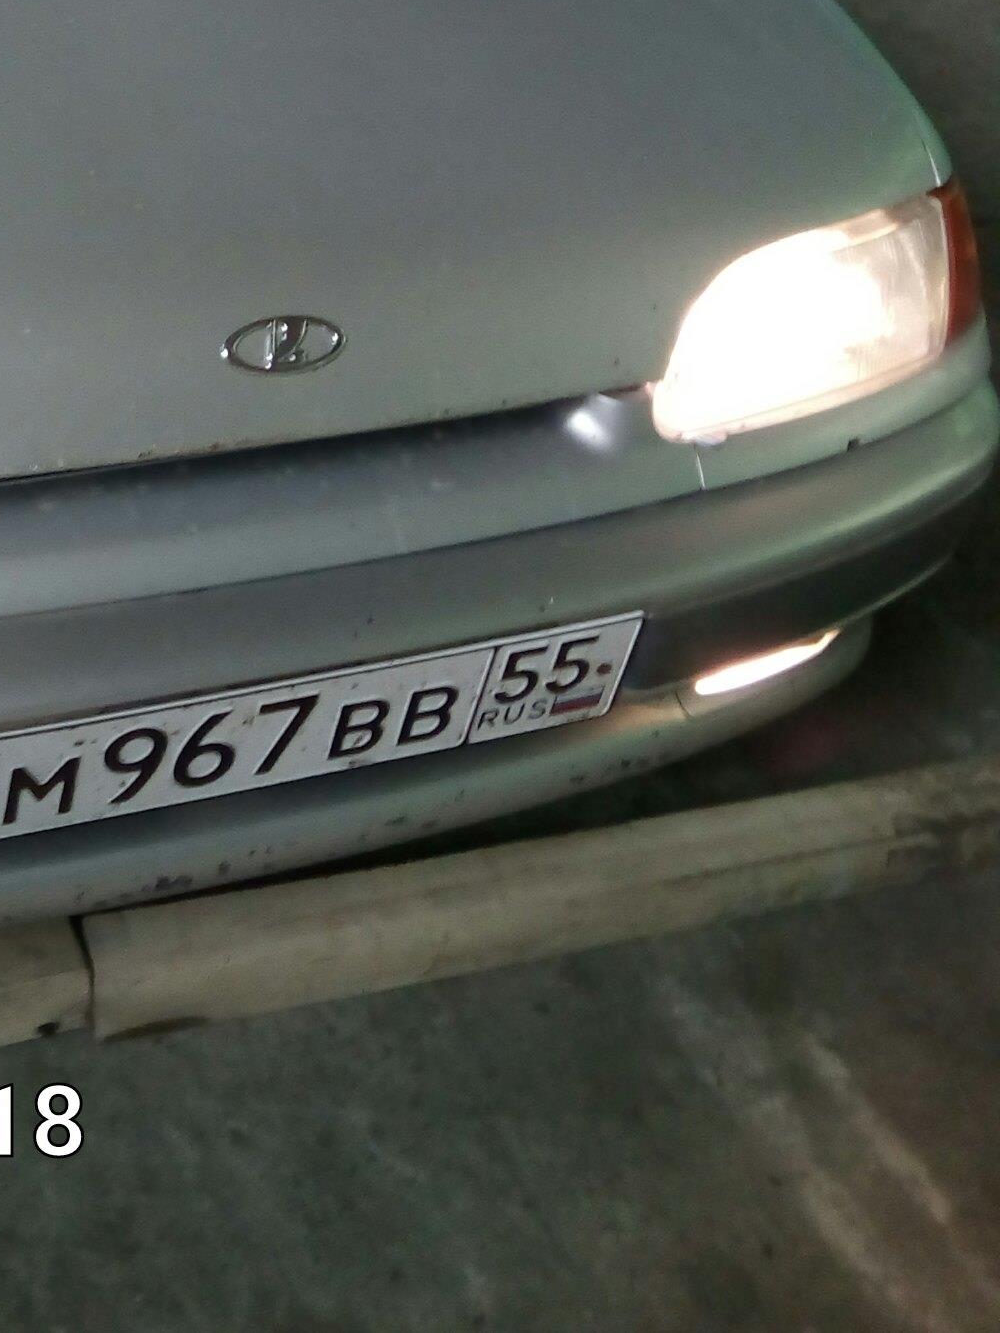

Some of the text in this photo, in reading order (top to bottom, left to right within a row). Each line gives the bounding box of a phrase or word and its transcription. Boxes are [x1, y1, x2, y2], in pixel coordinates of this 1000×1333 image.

[1, 635, 600, 826] М967ВВ 55
[476, 697, 549, 731] RUS
